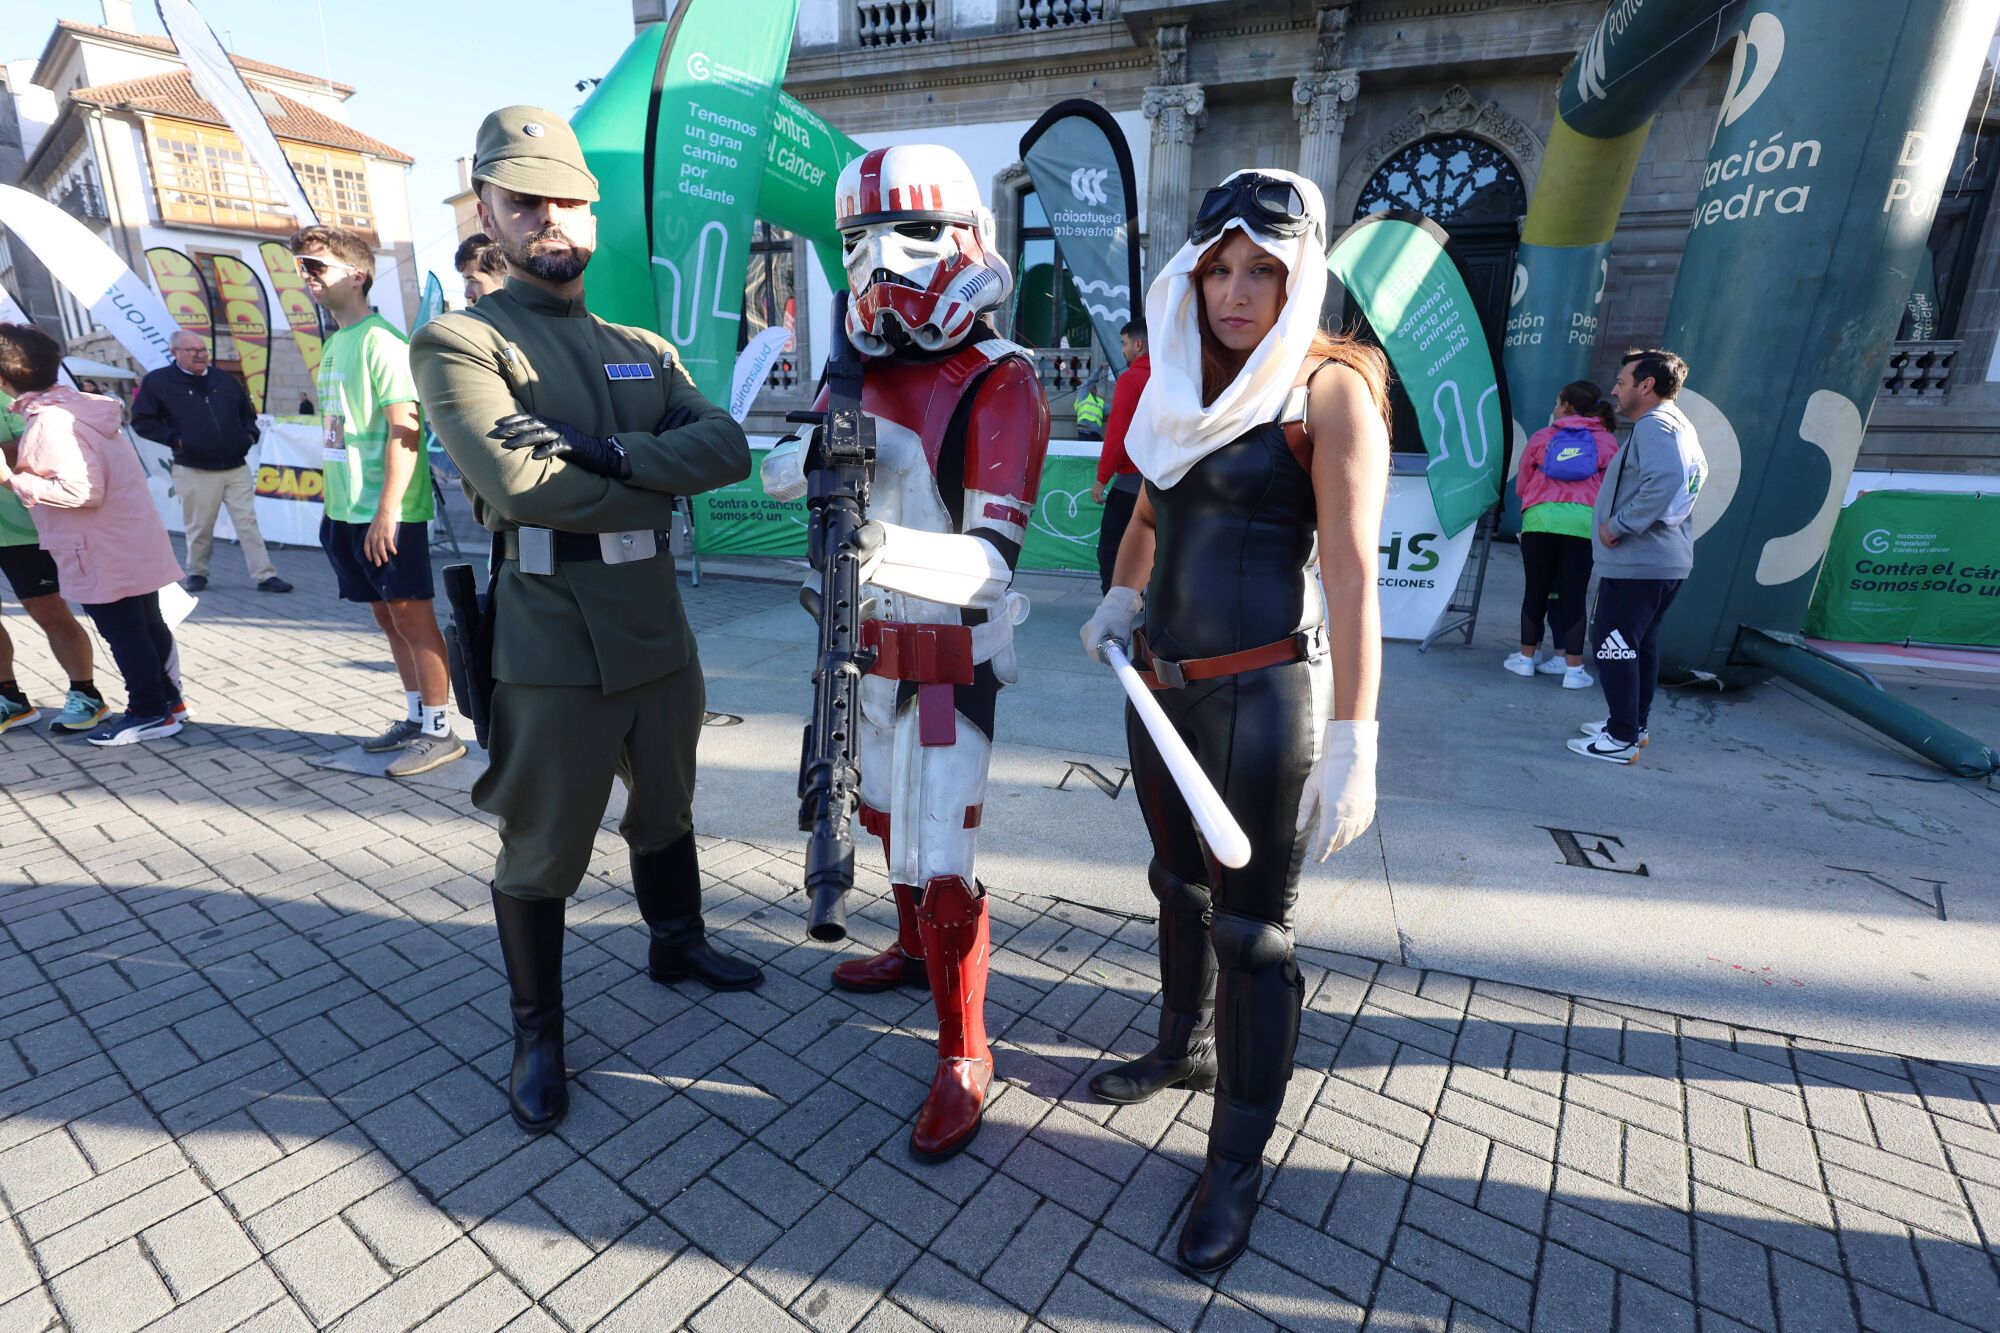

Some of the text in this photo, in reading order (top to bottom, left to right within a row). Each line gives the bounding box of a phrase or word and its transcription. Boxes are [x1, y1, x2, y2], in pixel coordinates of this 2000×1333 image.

[688, 101, 757, 137] Tenemos
[685, 124, 743, 151] un gran
[773, 111, 811, 149] ontra
[683, 144, 738, 168] camino
[680, 162, 708, 179] por
[777, 146, 826, 187] cáncer
[678, 179, 735, 205] delante
[1692, 184, 1810, 230] vedra
[1568, 330, 1595, 346] Pon
[1562, 447, 1580, 456] NIKE
[708, 498, 803, 511] Contra o cancro
[710, 512, 748, 521] somos
[766, 513, 782, 521] un
[1855, 559, 1928, 576] Contra
[1932, 561, 1955, 576] el
[1850, 578, 1919, 592] somos
[1921, 578, 1973, 594] solo
[1597, 648, 1637, 659] adidas
[1534, 825, 1649, 877] E
